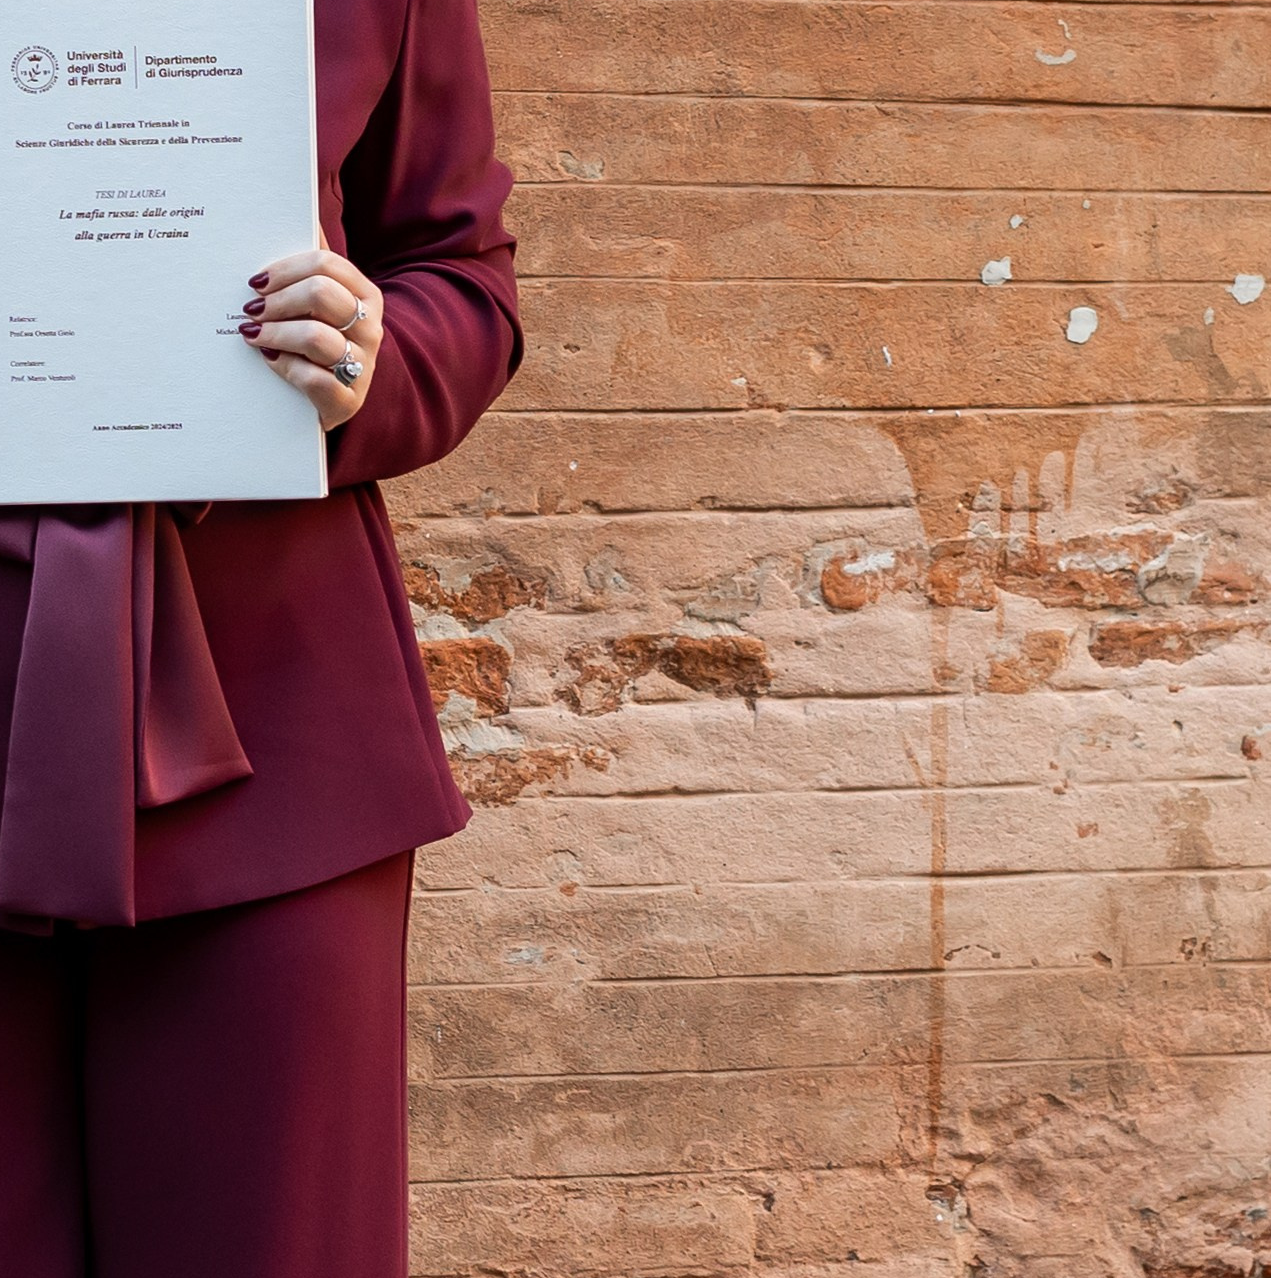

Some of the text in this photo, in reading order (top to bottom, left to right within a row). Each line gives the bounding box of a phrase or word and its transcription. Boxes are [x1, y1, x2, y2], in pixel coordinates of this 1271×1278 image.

[67, 50, 123, 61] Università
[145, 55, 217, 67] Dipartimento
[67, 62, 127, 75] degli Studi
[145, 67, 243, 79] di Giurisprudenza
[68, 76, 121, 86] di Ferrara
[67, 120, 190, 130] Corso di Laurea Triennale in
[15, 140, 46, 148] Scienze
[49, 138, 94, 147] Giuridiche
[96, 138, 116, 146] della
[119, 137, 159, 146] Sicurezza
[168, 136, 189, 145] della
[191, 135, 243, 144] Prevenzione
[95, 189, 167, 199] TESI DI LAUREA
[59, 206, 204, 221] La mafia russa: dalle origini
[75, 228, 189, 242] alla guerra in Ucraina
